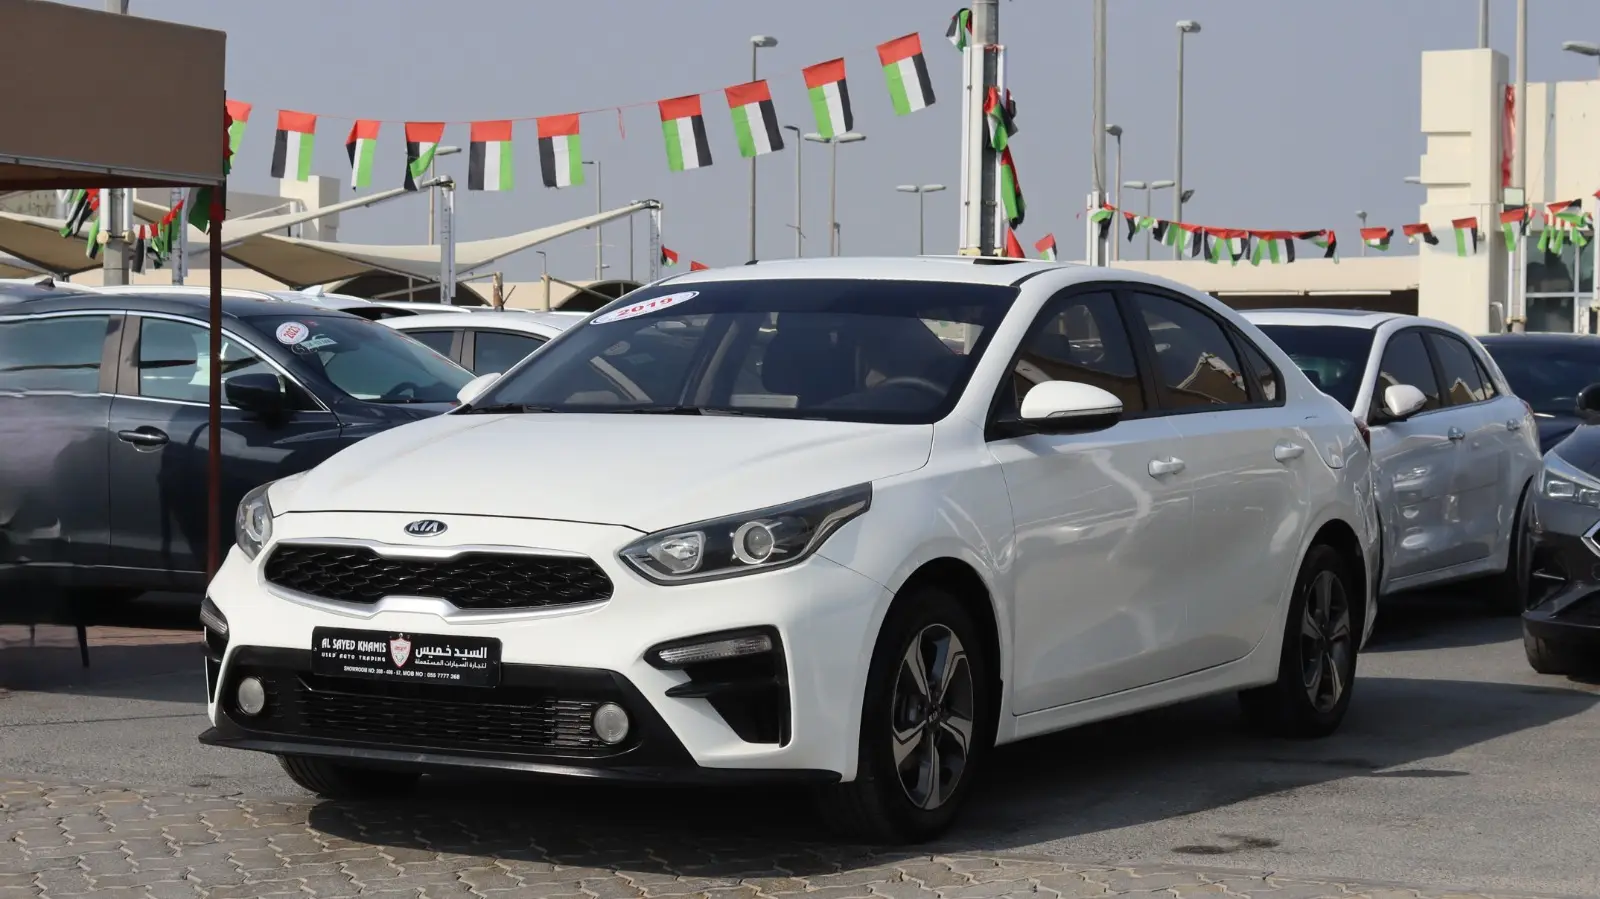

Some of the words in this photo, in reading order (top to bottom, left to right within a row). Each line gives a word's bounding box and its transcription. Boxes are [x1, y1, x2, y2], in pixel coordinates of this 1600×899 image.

[616, 298, 673, 316] 2019
[408, 520, 439, 532] KIA
[321, 638, 331, 649] AL
[332, 638, 356, 651] SAYED
[357, 640, 387, 653] KHAMIS
[415, 644, 452, 659] خميس
[453, 646, 488, 661] السيد
[343, 665, 368, 673] SHOWROOM
[444, 660, 469, 668] السيارات
[469, 661, 487, 669] لتجارة
